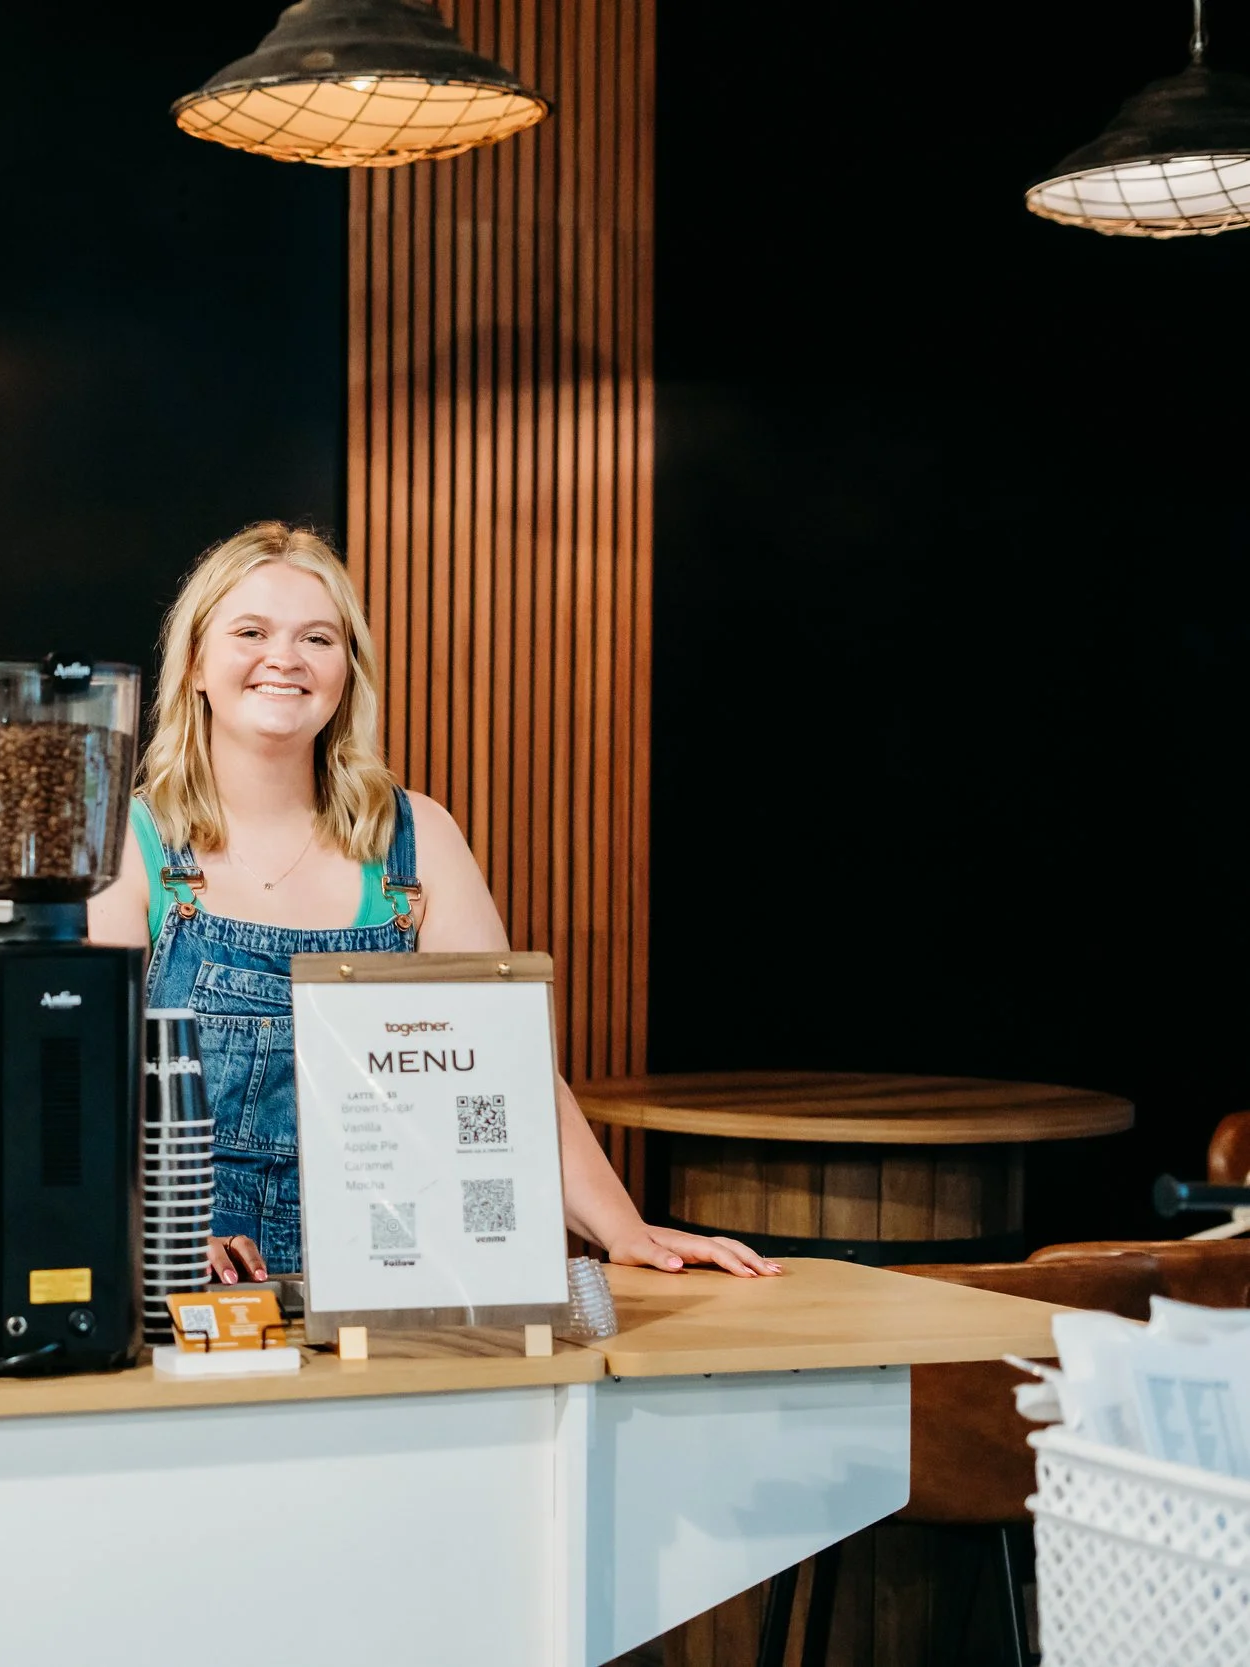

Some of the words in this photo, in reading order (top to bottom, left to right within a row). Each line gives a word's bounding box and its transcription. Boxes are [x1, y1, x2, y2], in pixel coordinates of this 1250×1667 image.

[384, 1021, 454, 1037] together.
[368, 1049, 475, 1074] MENU
[341, 1102, 379, 1114] Brown
[342, 1121, 382, 1133] Vanilla
[344, 1141, 378, 1154] Apple
[380, 1140, 399, 1152] Pie
[344, 1160, 395, 1172] Caramel
